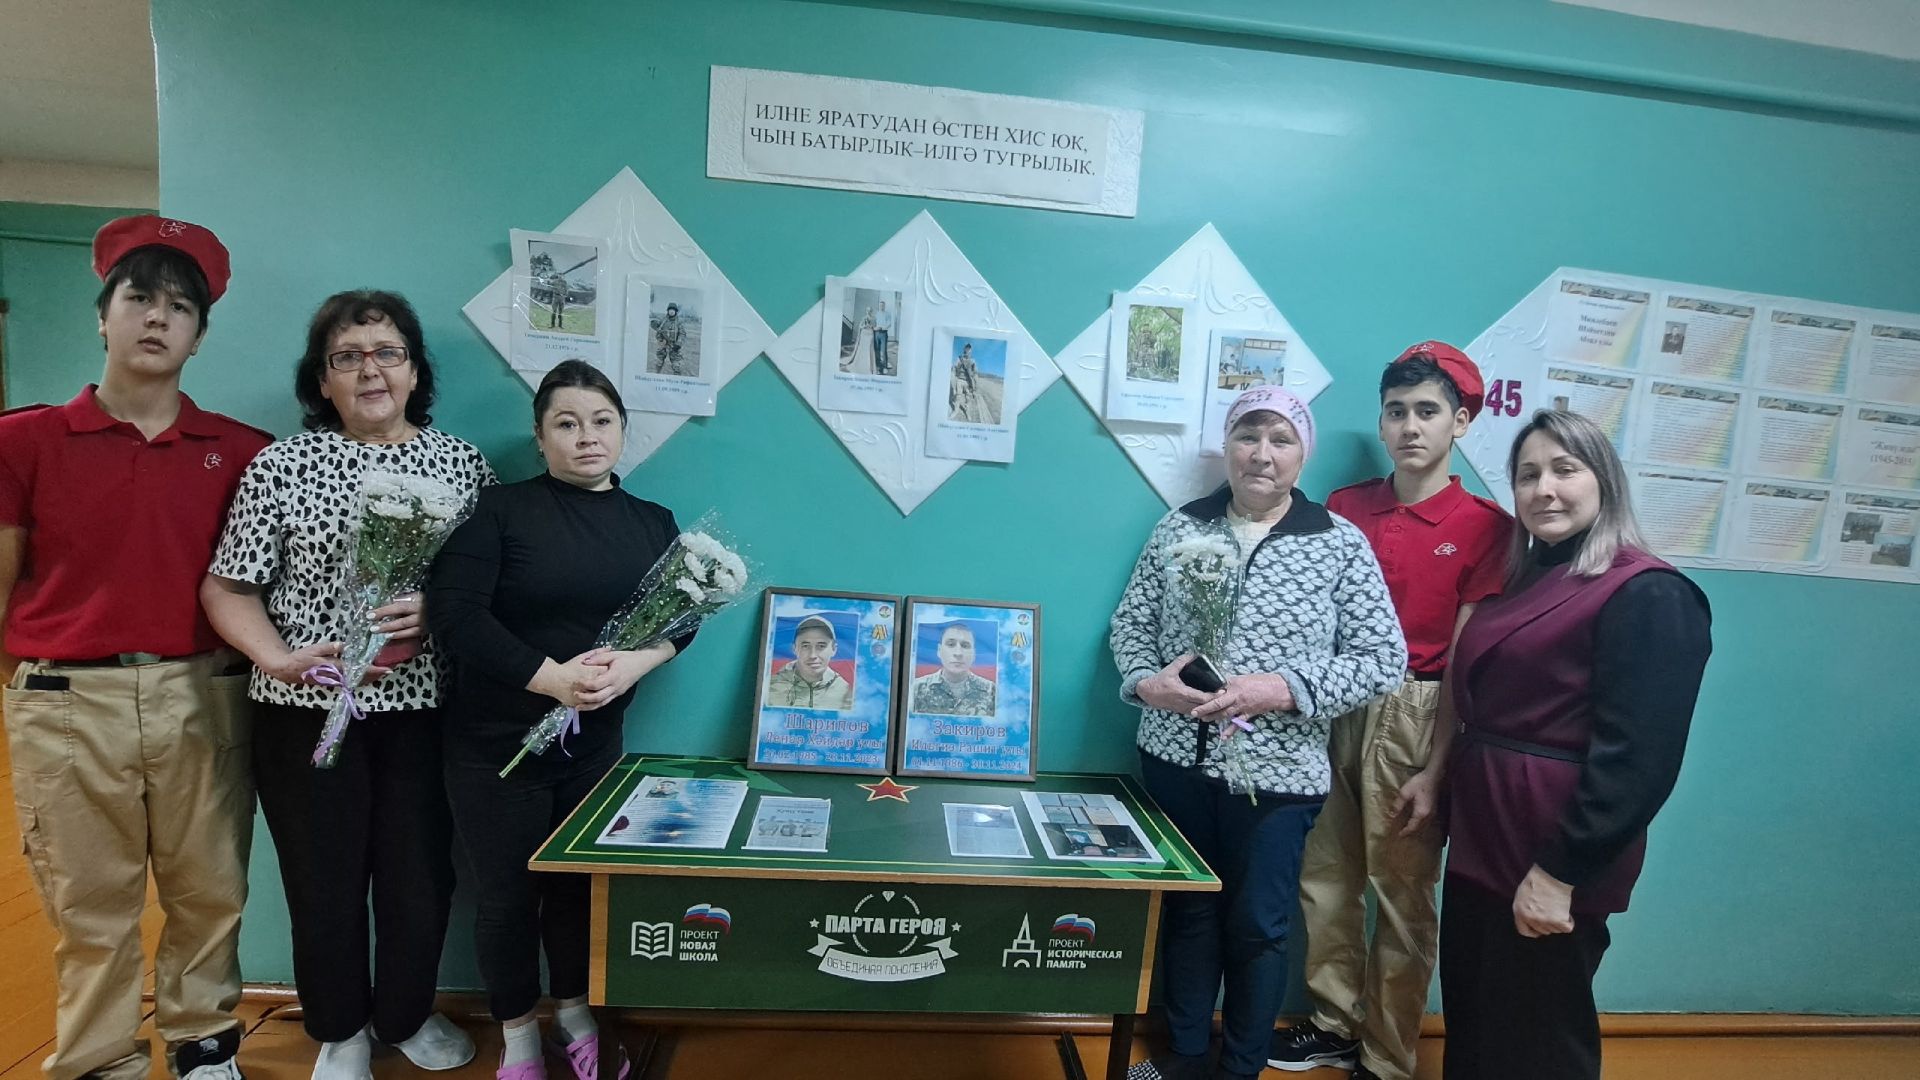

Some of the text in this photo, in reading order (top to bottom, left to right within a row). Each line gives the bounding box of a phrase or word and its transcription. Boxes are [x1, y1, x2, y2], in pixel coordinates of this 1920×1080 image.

[756, 104, 1088, 154] ИЛНЕ ЯРАТУДАН ӨСТЕН ХИС ЮК,
[750, 127, 796, 147] ЧЫН
[983, 148, 1096, 176] ТУГРЫЛЫК.
[1485, 379, 1522, 417] 45
[785, 713, 870, 733] Шарипов
[933, 719, 1007, 740] Закиров
[825, 914, 947, 936] ПАРТА ГЕРОЯ
[680, 930, 720, 939] ПРОЕКТ
[680, 941, 717, 950] НОВАЯ
[1048, 938, 1085, 948] ПРОЕКТ
[679, 952, 719, 962] ШКОЛА
[1047, 949, 1123, 959] ИСТОРИЧЕСКАЯ
[1046, 959, 1087, 969] ПАМЯТЬ
